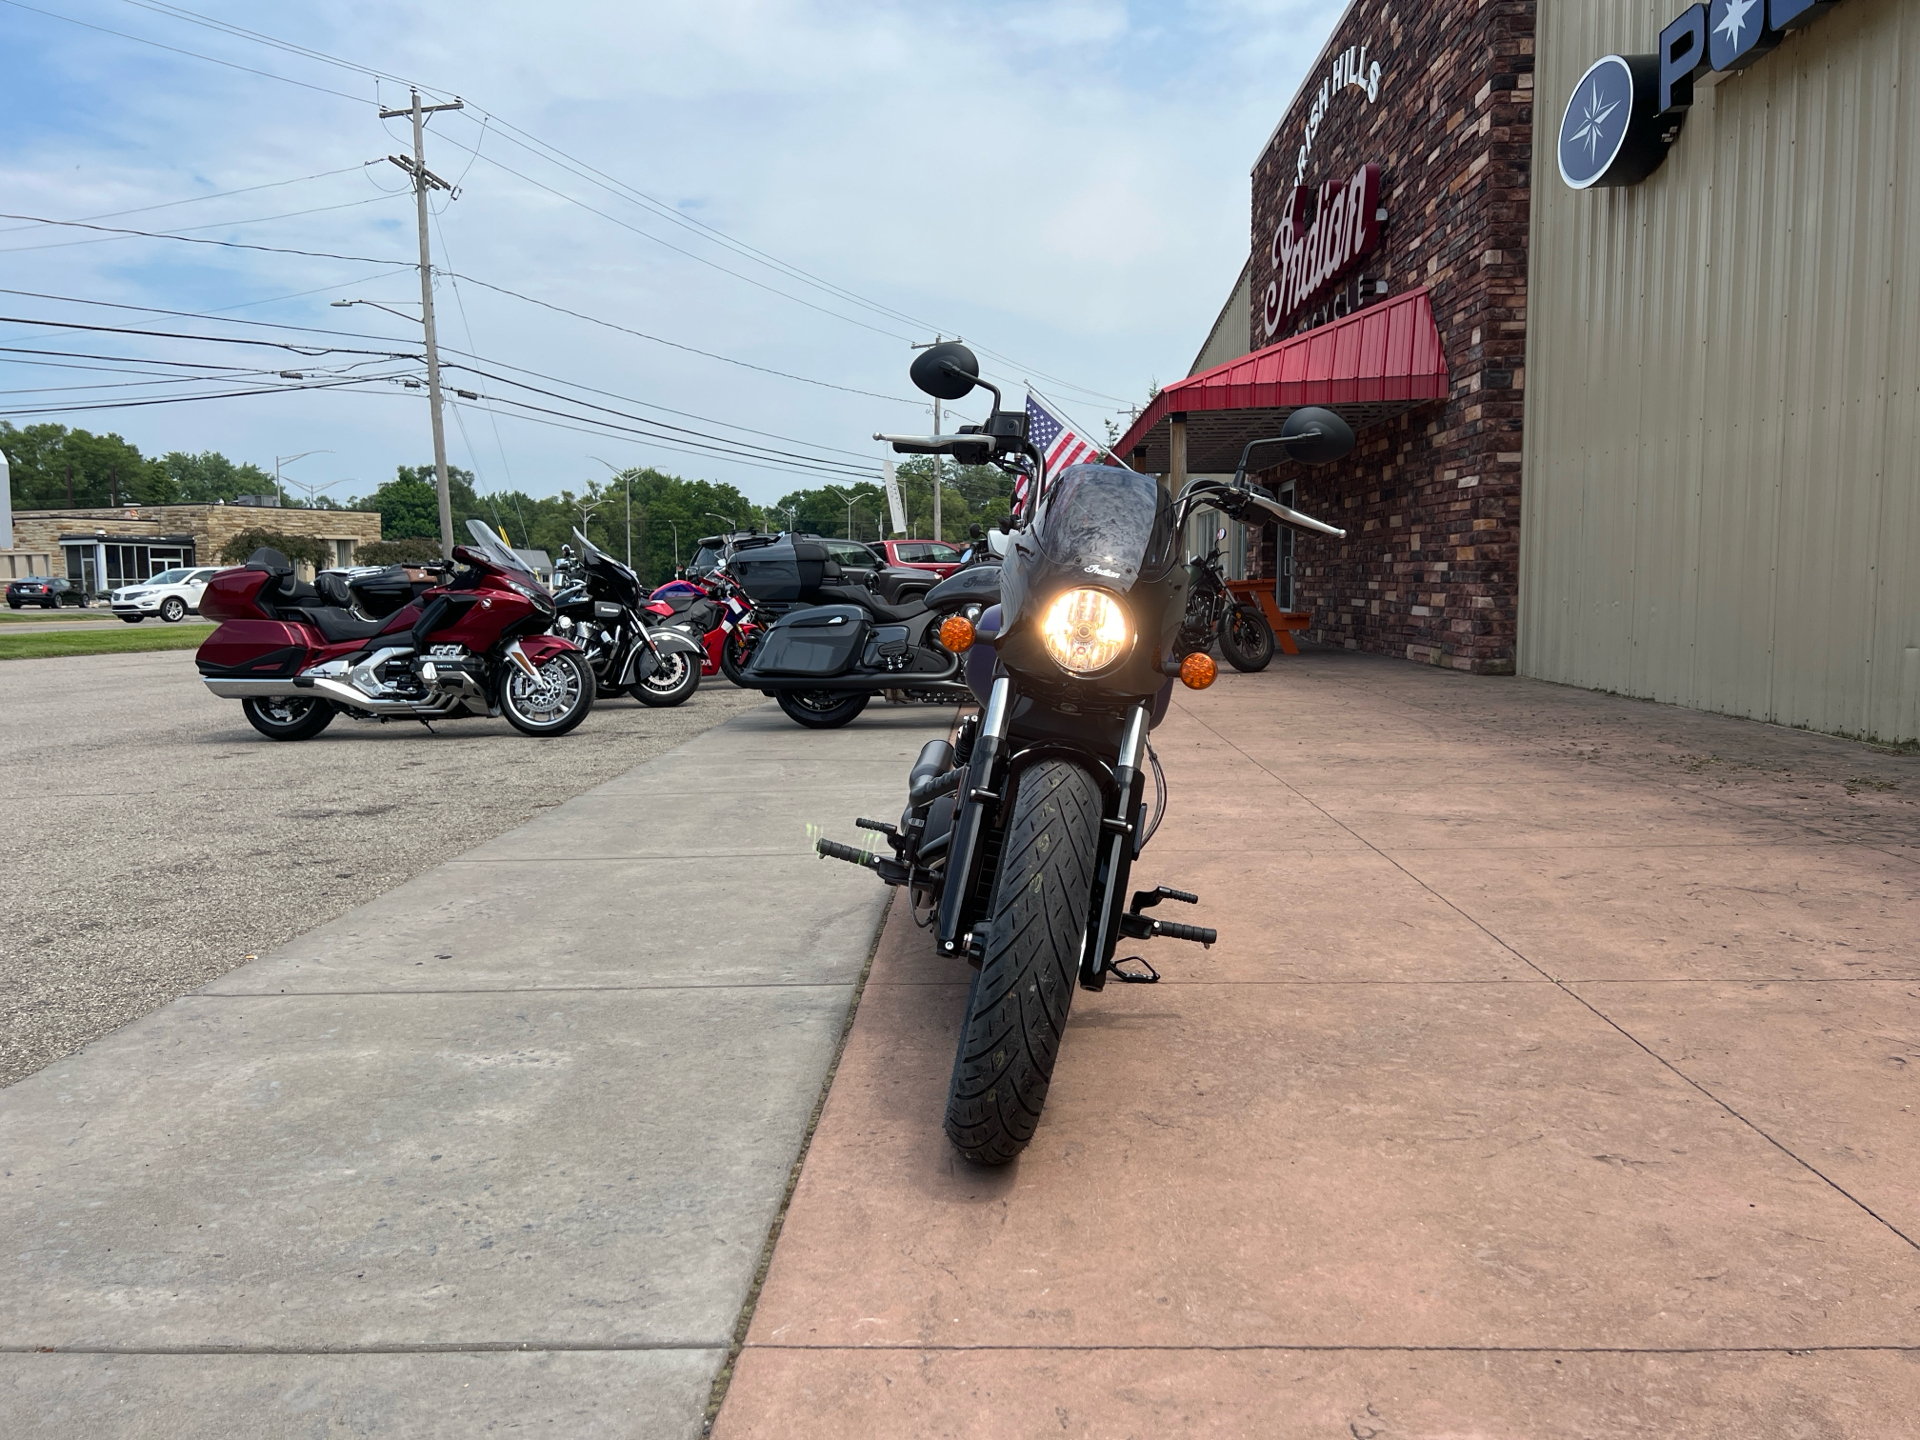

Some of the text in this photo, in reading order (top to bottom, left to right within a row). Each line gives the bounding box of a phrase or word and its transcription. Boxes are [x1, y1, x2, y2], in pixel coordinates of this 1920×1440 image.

[1332, 46, 1381, 104] HILLS
[1265, 164, 1367, 338] Indian
[1084, 564, 1121, 579] Indian
